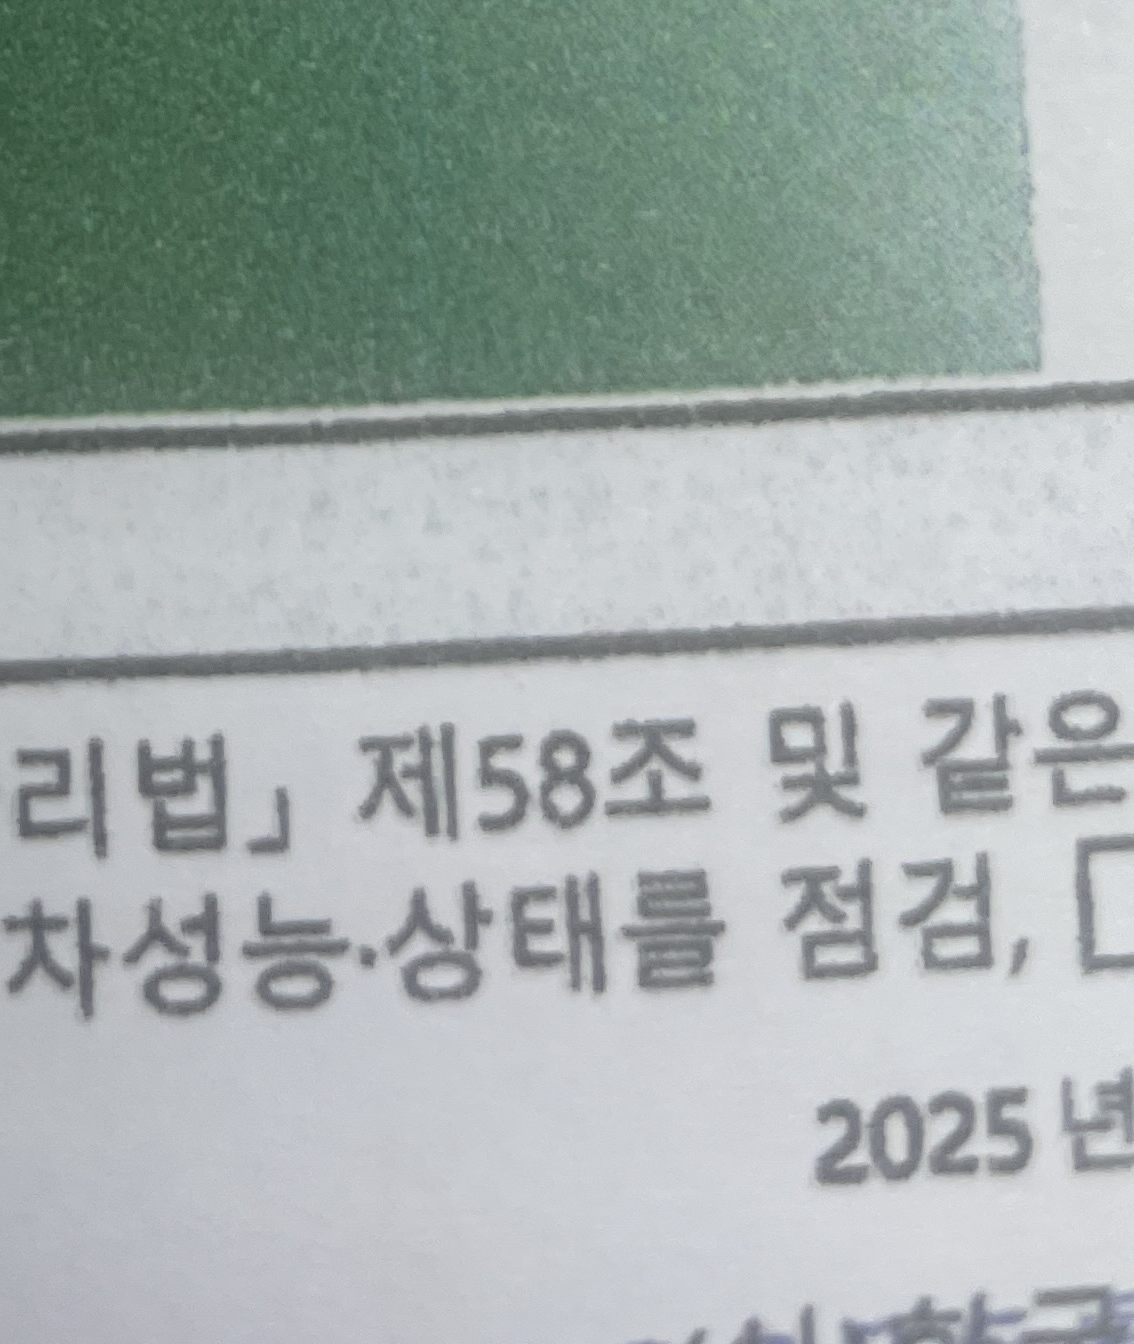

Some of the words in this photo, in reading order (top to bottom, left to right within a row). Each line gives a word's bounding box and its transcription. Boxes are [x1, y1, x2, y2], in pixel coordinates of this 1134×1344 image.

[358, 716, 710, 841] 제58조
[768, 700, 866, 824] 및
[921, 689, 1134, 815] 같은
[782, 850, 1030, 984] 점검,
[816, 1086, 1034, 1186] 2025
[1061, 1066, 1134, 1172] 년
